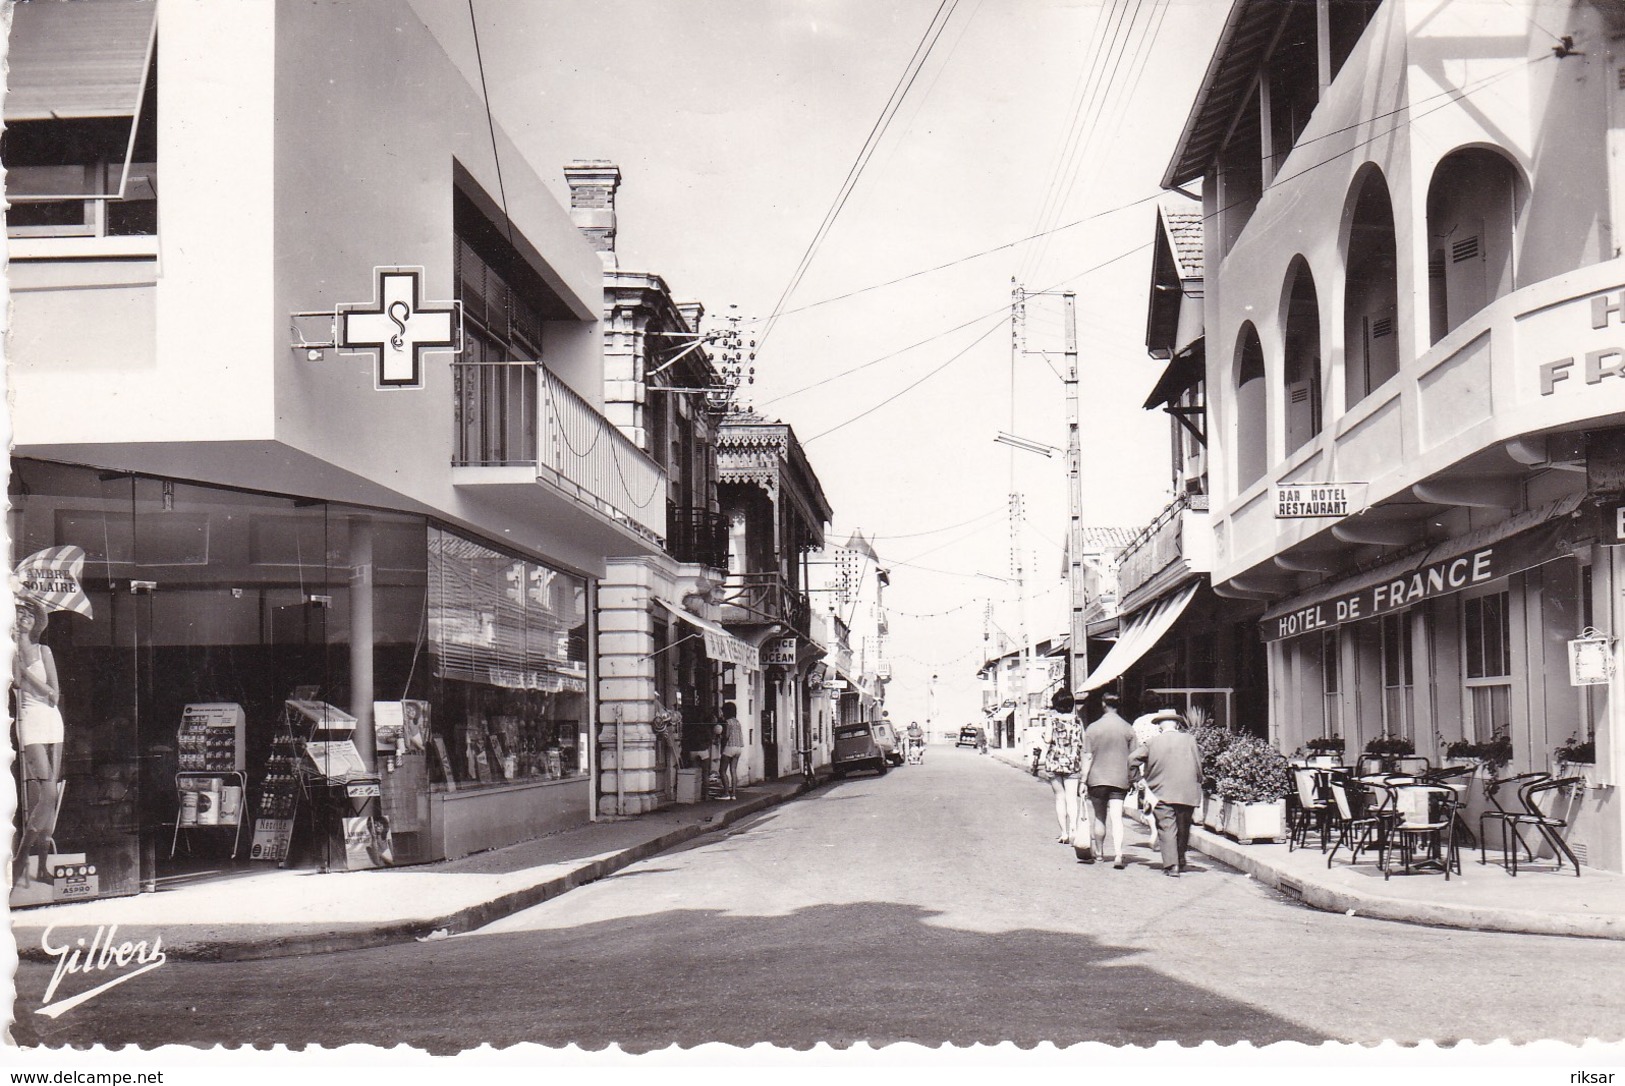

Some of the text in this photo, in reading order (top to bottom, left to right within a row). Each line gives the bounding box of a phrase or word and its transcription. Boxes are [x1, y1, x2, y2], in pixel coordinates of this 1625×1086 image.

[1539, 346, 1625, 397] FR
[1279, 488, 1346, 502] BAR HOTEL
[1279, 501, 1348, 515] RESTAURANT
[26, 568, 73, 580] AMBRE
[22, 580, 77, 593] SOLAIRE
[1278, 549, 1493, 638] HOTEL DE FRANCE
